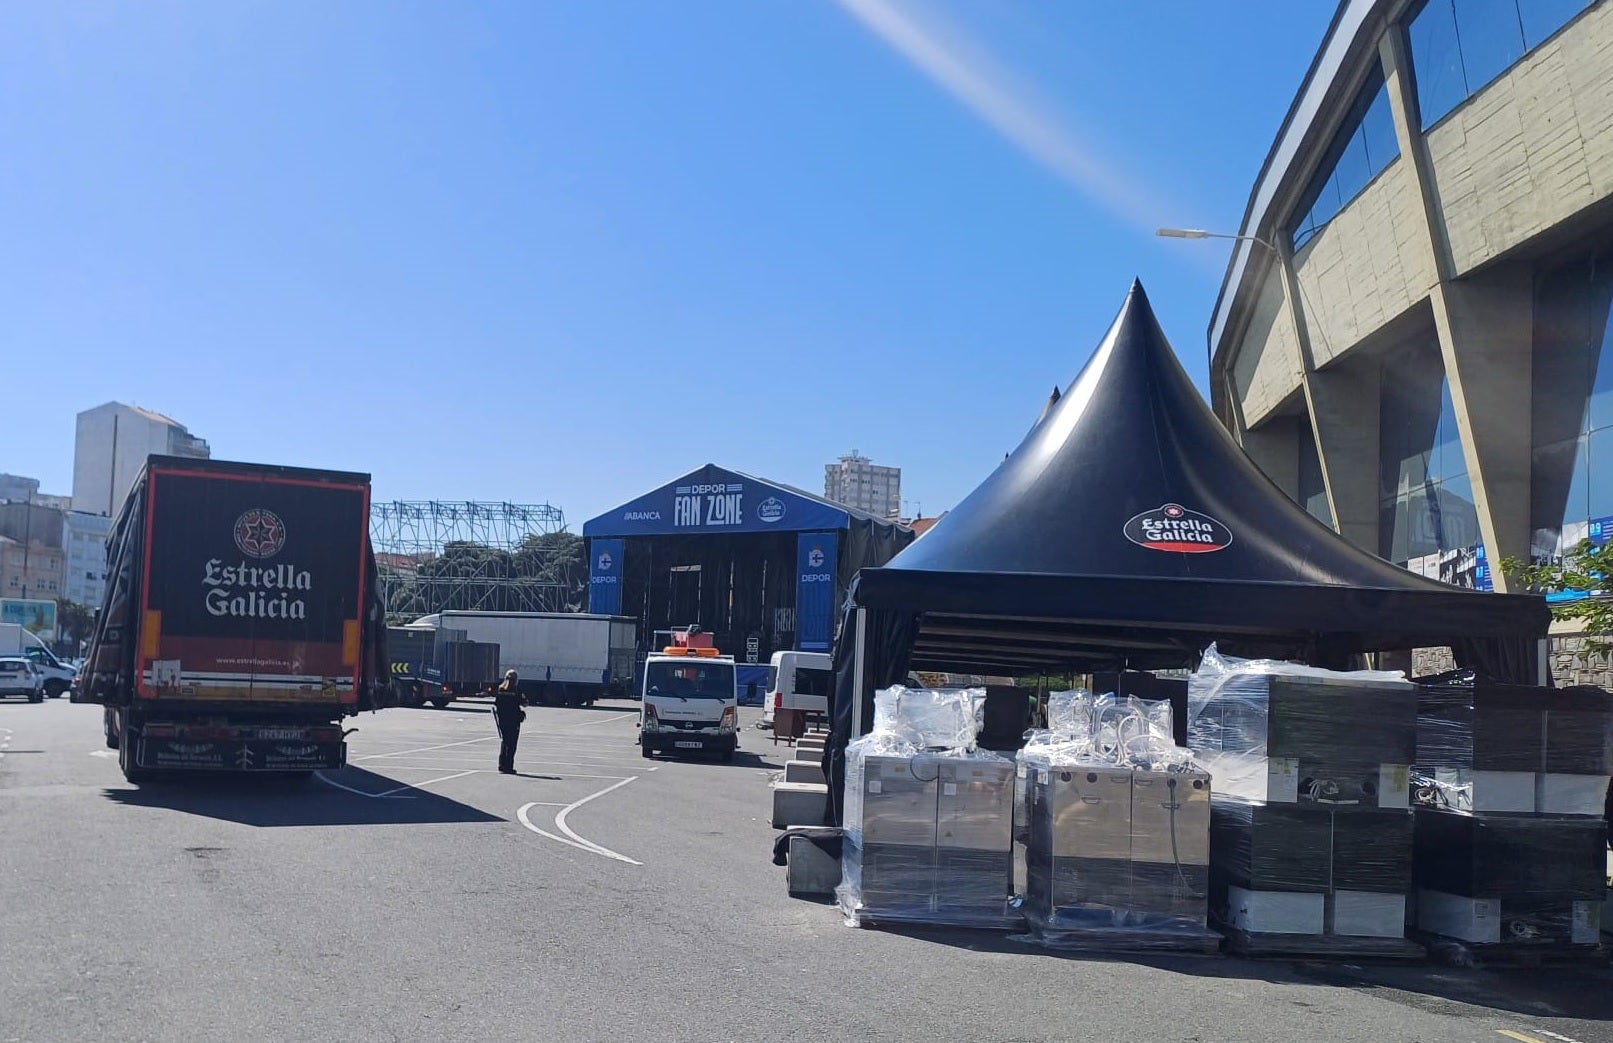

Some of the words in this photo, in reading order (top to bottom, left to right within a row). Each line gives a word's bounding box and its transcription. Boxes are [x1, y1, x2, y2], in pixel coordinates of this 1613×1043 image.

[691, 484, 726, 494] DEPOR
[674, 496, 700, 526] FAN
[706, 494, 742, 525] ZONE
[1142, 518, 1213, 532] Estrella
[1146, 529, 1213, 543] Galicia
[202, 558, 312, 590] Estrella
[592, 576, 617, 584] DEPOR
[801, 574, 831, 583] DEPOR
[206, 588, 306, 619] Galicia
